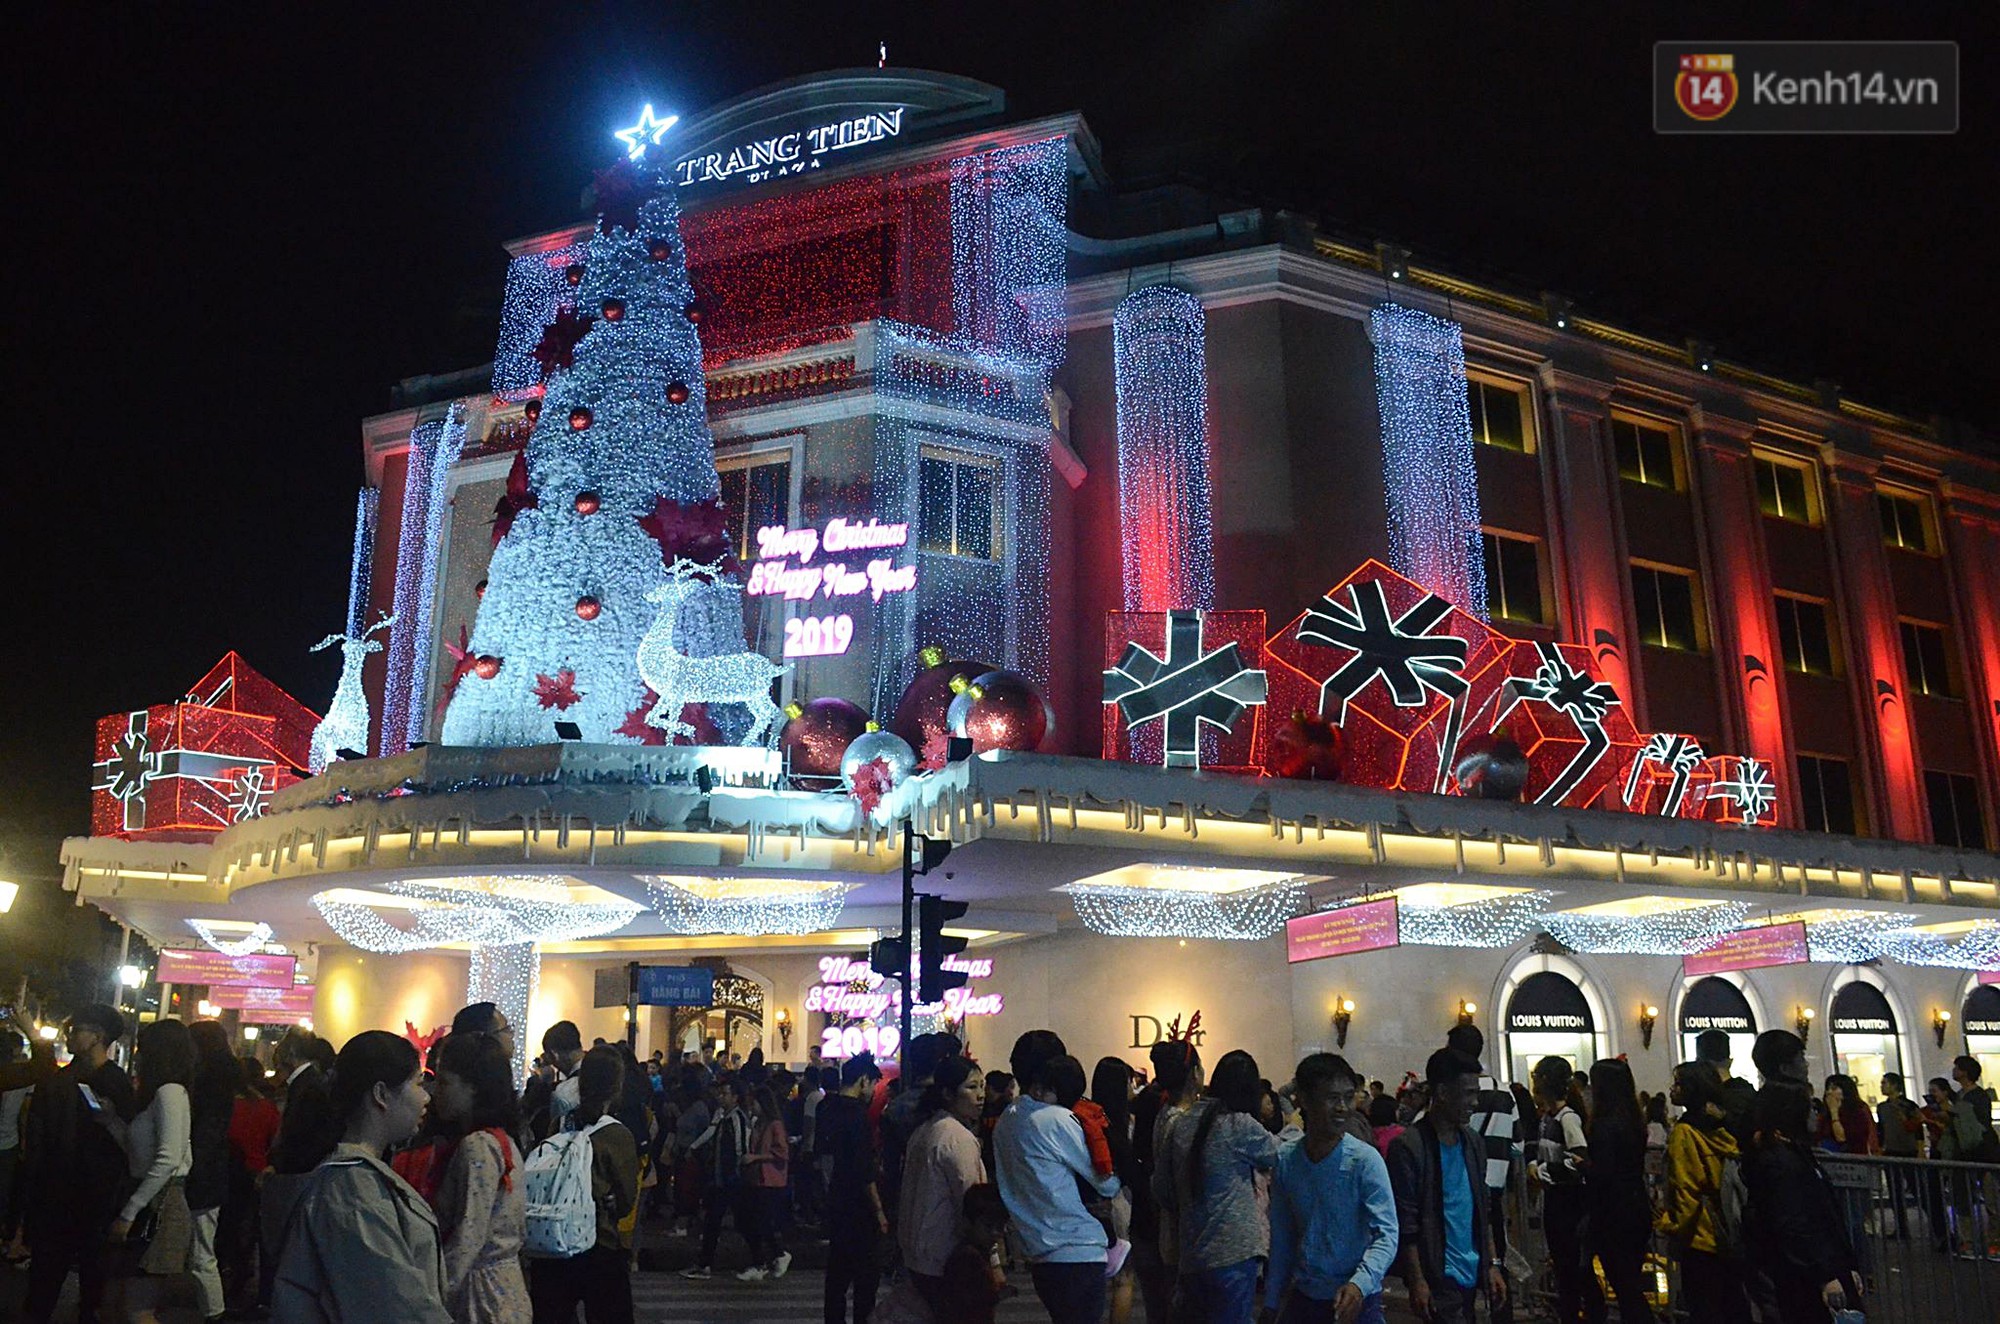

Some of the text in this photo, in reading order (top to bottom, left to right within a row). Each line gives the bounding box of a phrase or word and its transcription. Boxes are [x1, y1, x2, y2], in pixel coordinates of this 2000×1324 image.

[676, 107, 904, 186] TRANG TIEN
[757, 517, 909, 564] Merry Christmas
[822, 563, 869, 600] New
[866, 558, 918, 604] Year
[783, 614, 854, 658] 2019
[942, 986, 1005, 1025] Year
[1512, 1015, 1585, 1027] LOUIS VUITTON
[1685, 1017, 1748, 1029] LOUIS VUITTON
[1834, 1018, 1856, 1030] LOUIS
[821, 1026, 901, 1059] 2019
